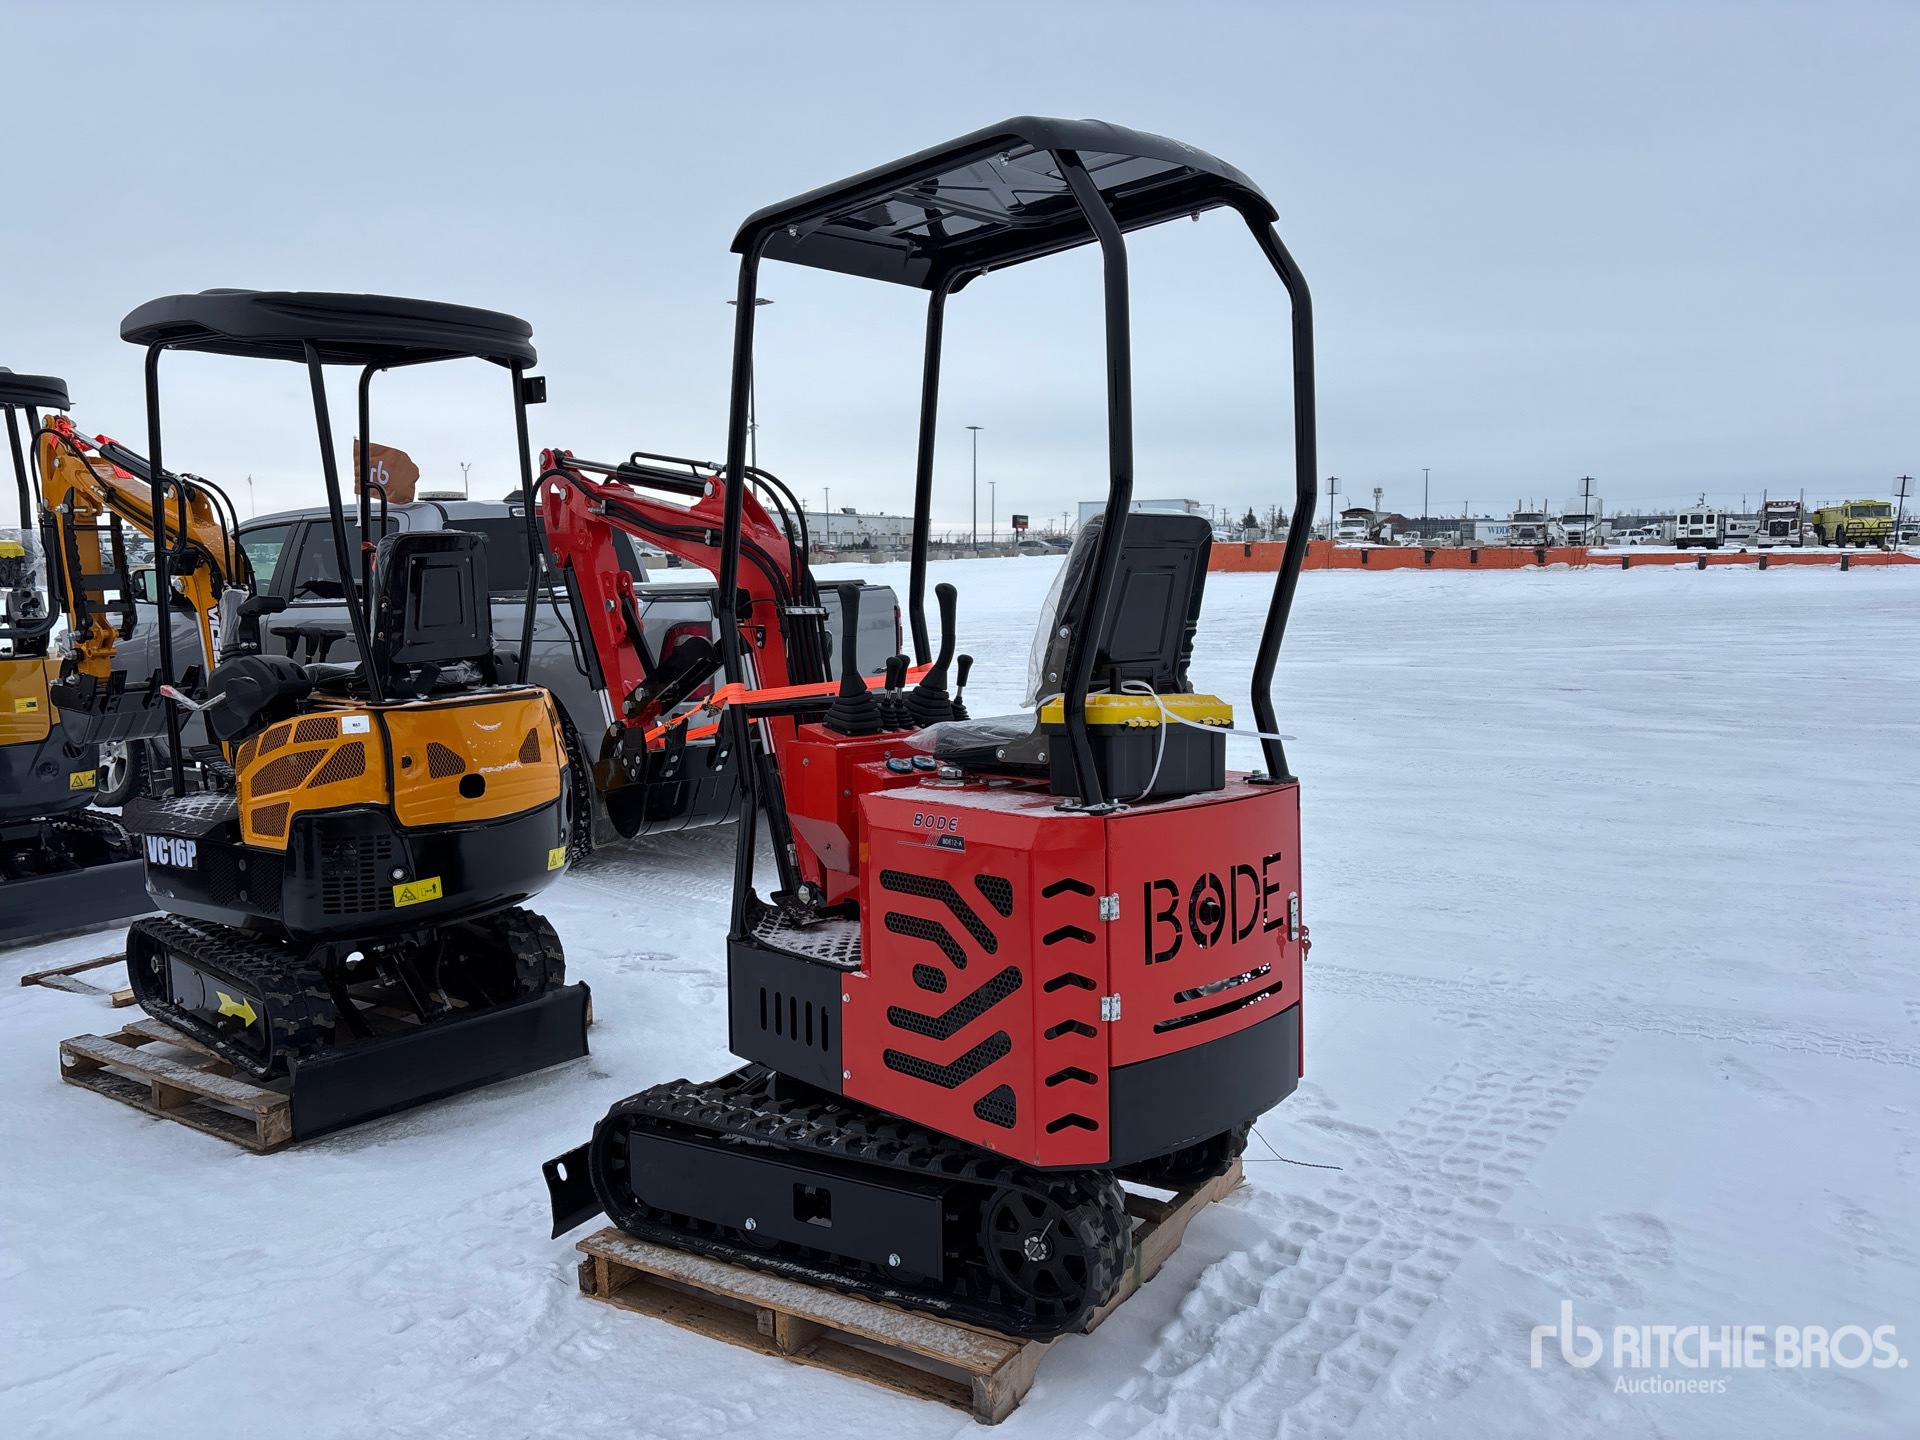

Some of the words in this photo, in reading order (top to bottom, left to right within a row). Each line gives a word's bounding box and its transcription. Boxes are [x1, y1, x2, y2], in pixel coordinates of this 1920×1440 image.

[370, 461, 389, 485] rb
[913, 812, 958, 832] BODE
[146, 836, 197, 868] VC16P
[1144, 852, 1283, 965] BODE
